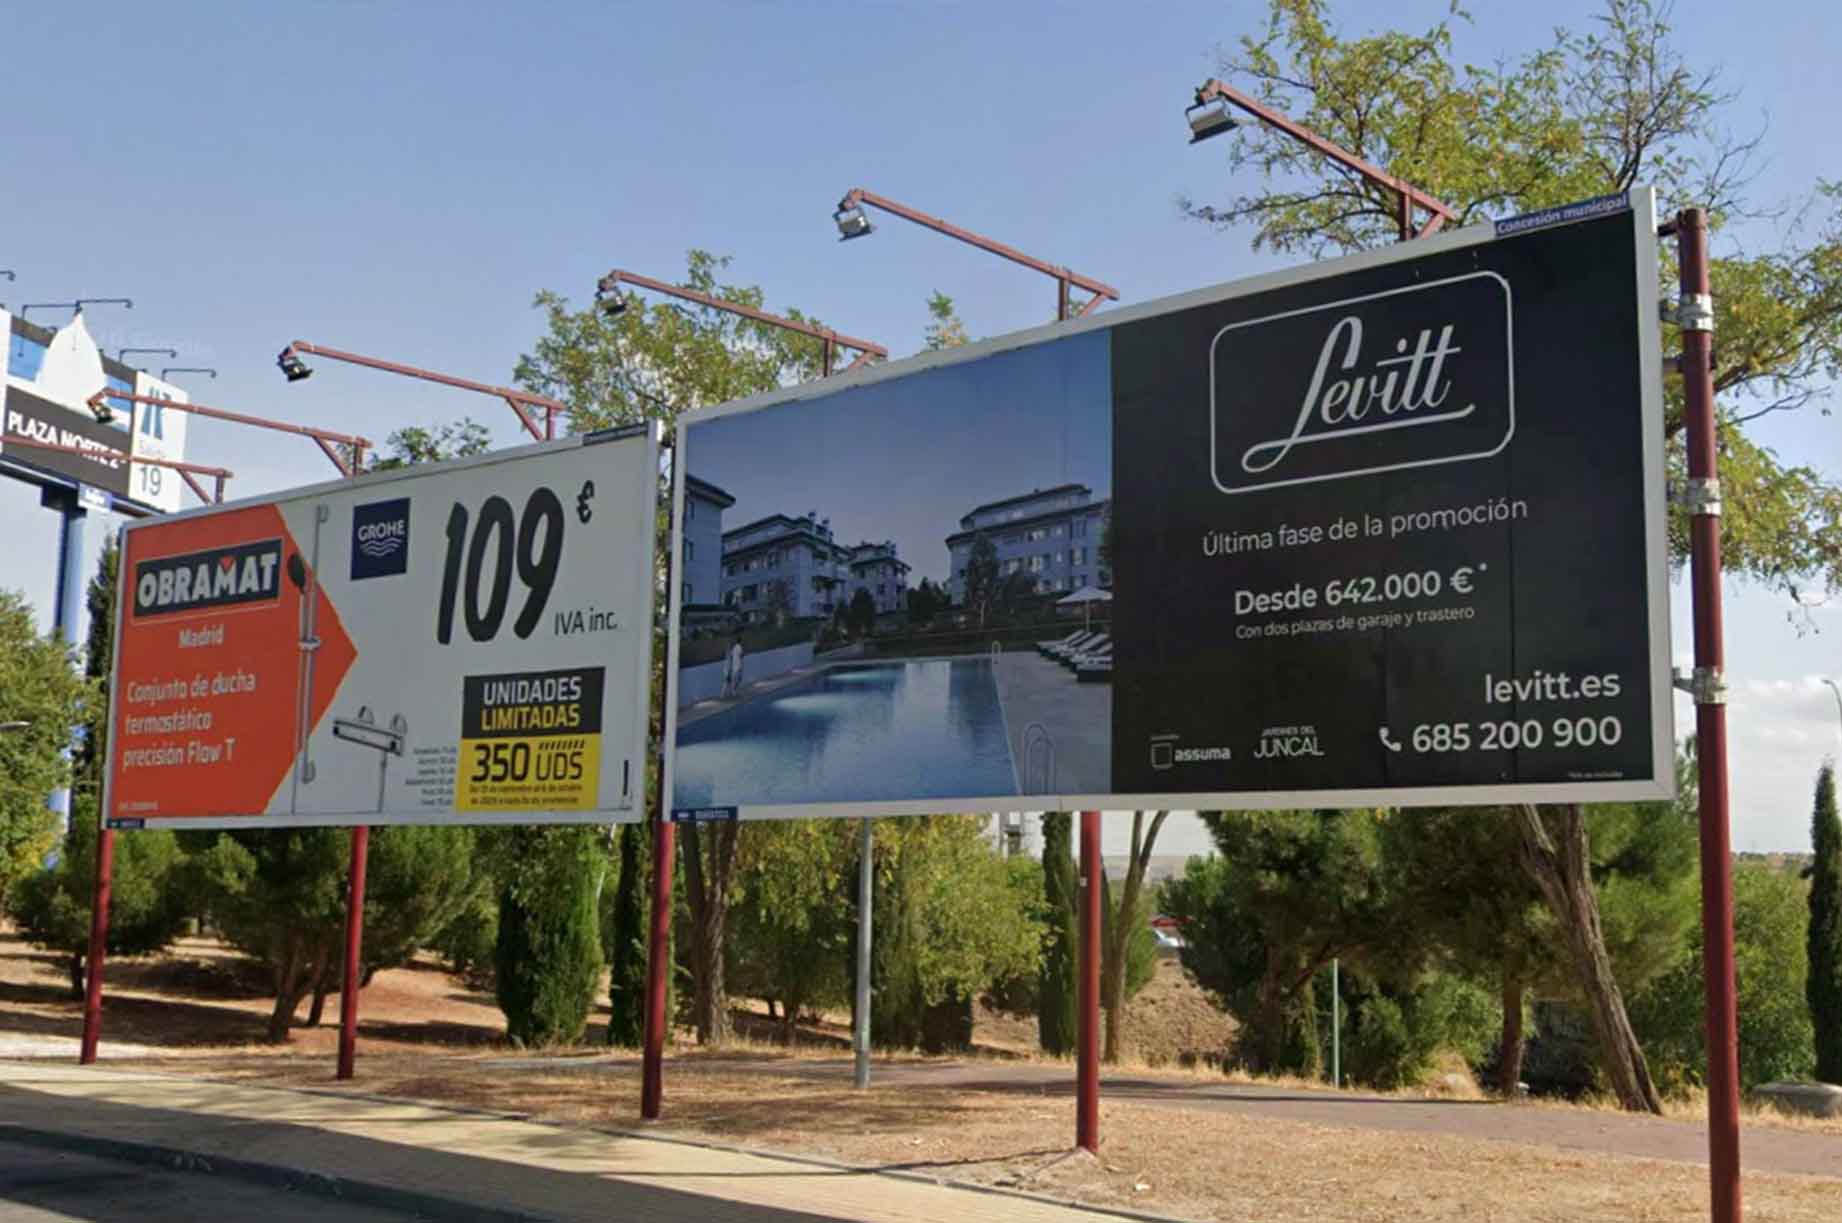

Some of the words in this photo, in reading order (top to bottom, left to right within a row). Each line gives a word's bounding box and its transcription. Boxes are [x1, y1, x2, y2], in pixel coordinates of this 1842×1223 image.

[1564, 193, 1628, 219] municipal
[1241, 316, 1476, 473] Levitt
[8, 410, 58, 445] PLAZA
[139, 466, 163, 497] 19
[357, 519, 406, 541] GROHE
[1203, 529, 1274, 557] Última
[1278, 523, 1324, 547] fase
[1328, 516, 1359, 541] de
[1364, 512, 1384, 537] la
[1391, 496, 1528, 537] promoción
[137, 552, 279, 608] OBRAMAT
[436, 486, 565, 646] 109
[1235, 583, 1318, 615] Desde
[1325, 570, 1442, 606] 642.000
[178, 625, 224, 648] Madrid
[554, 611, 585, 635] IVA
[1236, 624, 1263, 639] Con
[1264, 620, 1289, 636] dos
[1291, 616, 1335, 637] plazas
[1337, 614, 1356, 630] de
[1357, 611, 1402, 632] garaje
[1404, 611, 1414, 627] y
[1416, 605, 1475, 623] trastero
[128, 678, 188, 706] Conjunto
[191, 673, 209, 697] de
[212, 668, 256, 695] ducha
[483, 676, 582, 705] UNIDADES
[1485, 670, 1621, 703] levitt.es
[480, 704, 581, 732] LIMITADAS
[1412, 723, 1471, 752] 685
[1479, 719, 1543, 750] 200
[1552, 716, 1622, 747] 900
[121, 743, 185, 773] precisión
[187, 741, 223, 765] Flow
[225, 737, 236, 761] T
[471, 742, 531, 783] 350
[536, 751, 583, 781] UDS
[1174, 747, 1231, 762] assuma
[1254, 736, 1325, 758] JUNCAL
